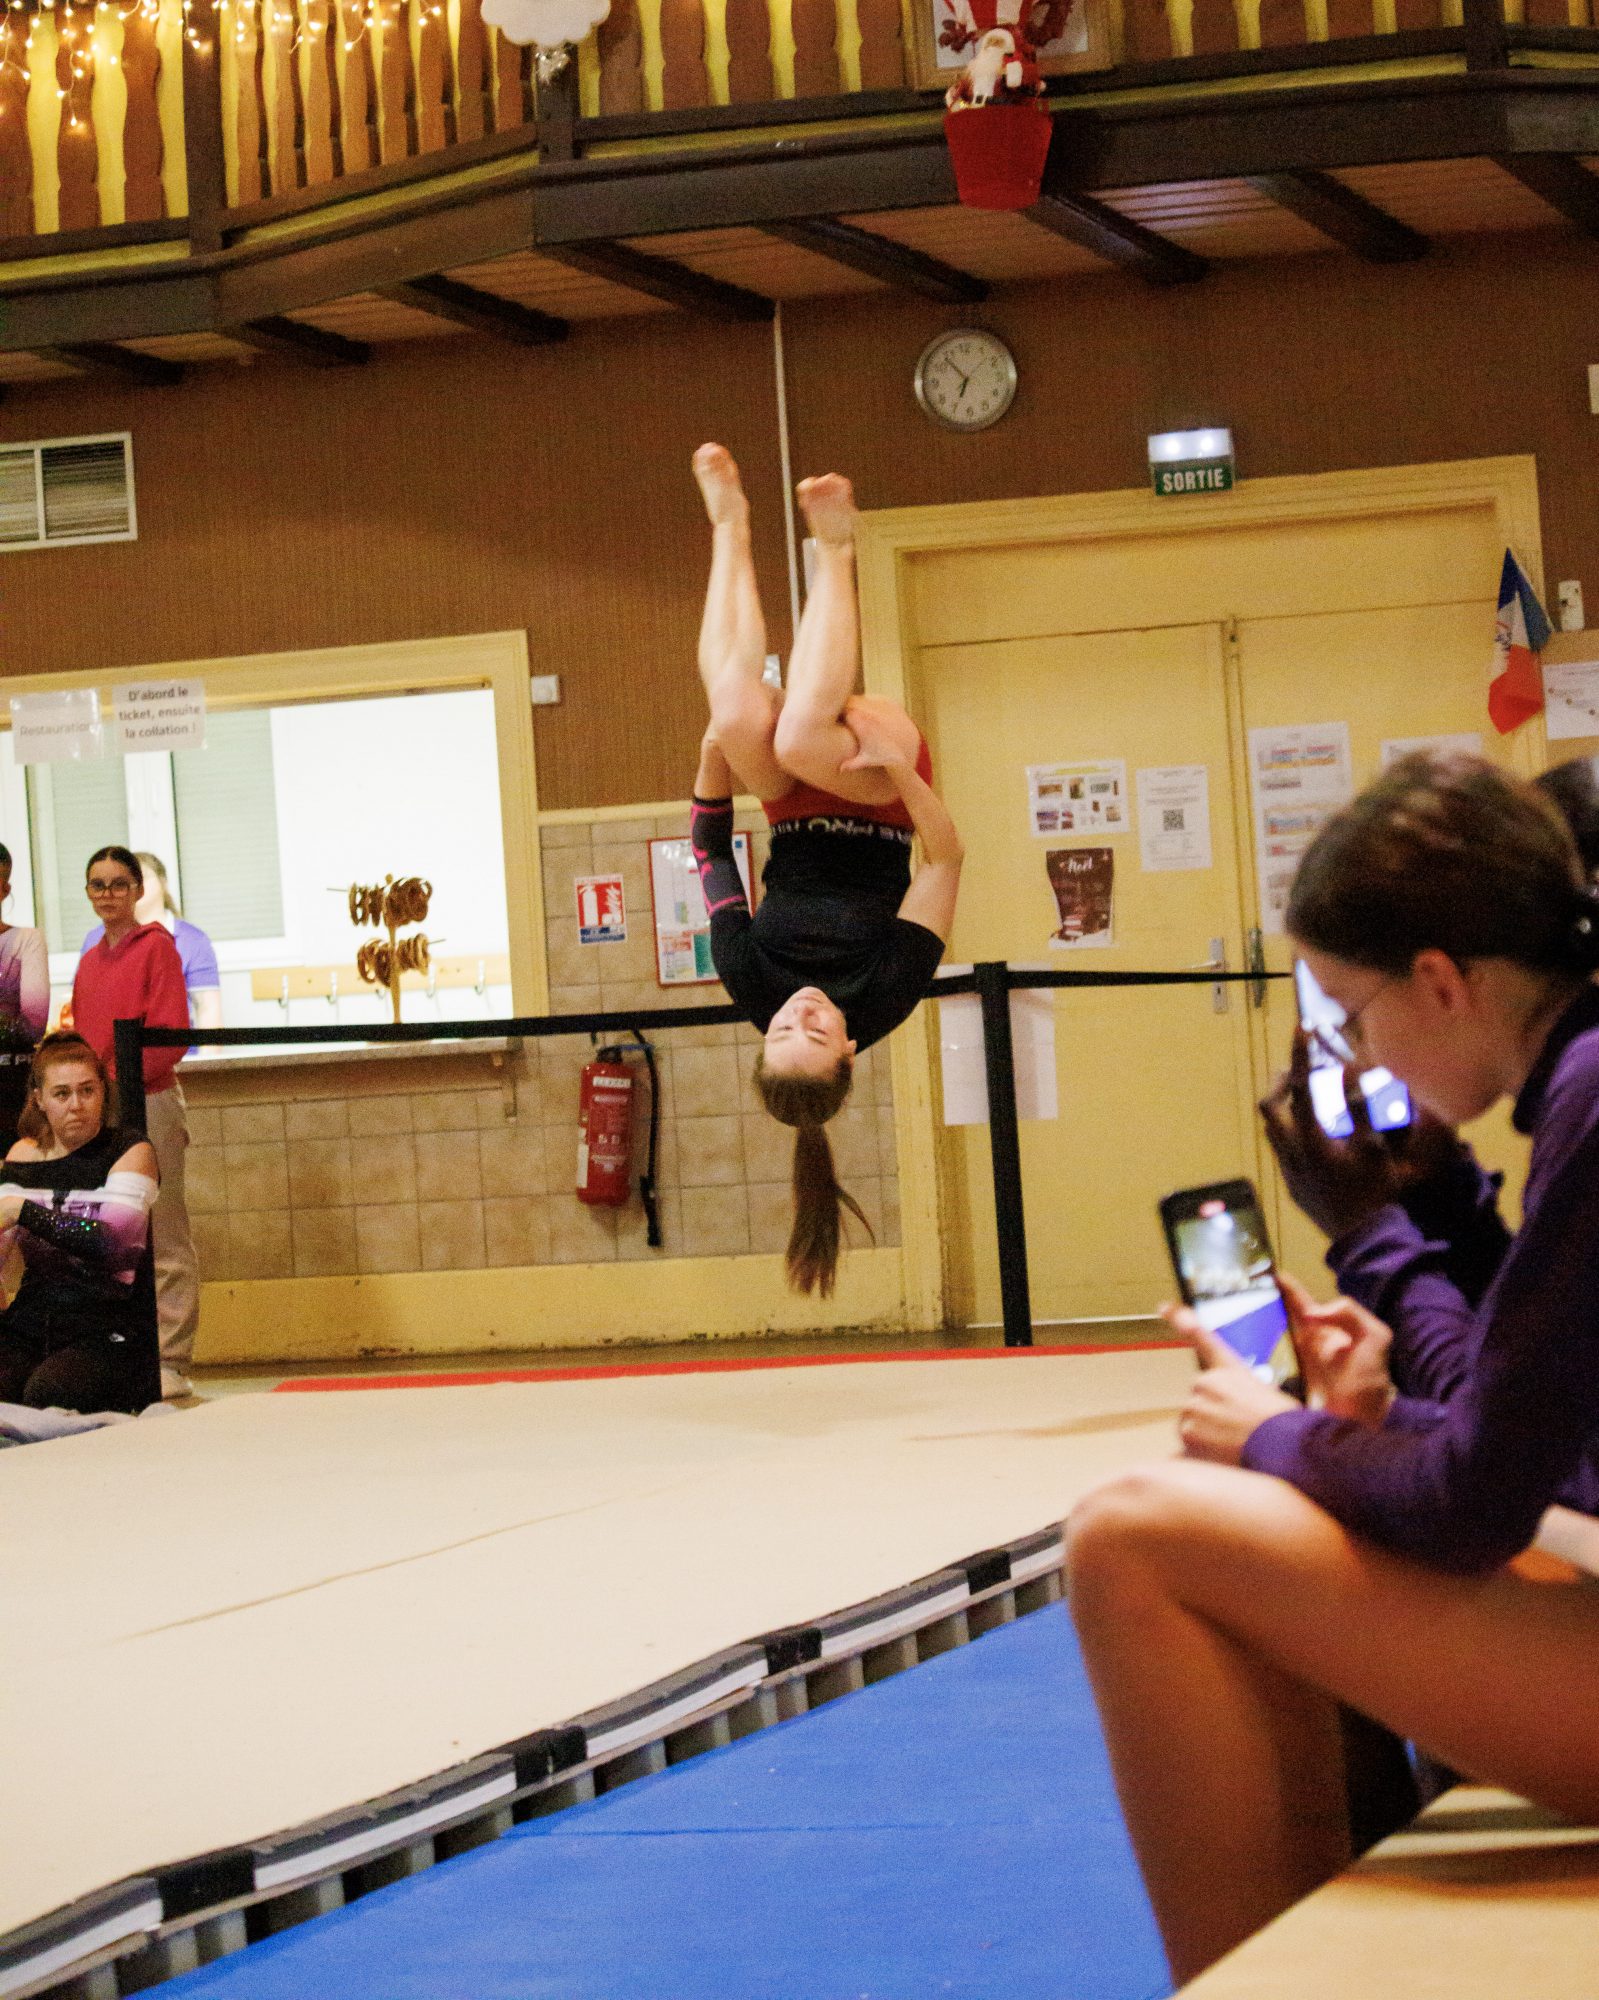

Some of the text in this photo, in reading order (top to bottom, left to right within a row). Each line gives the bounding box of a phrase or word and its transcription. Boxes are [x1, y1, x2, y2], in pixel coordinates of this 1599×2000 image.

[1163, 468, 1225, 493] SORTIE
[128, 687, 188, 701] D'abord le
[119, 704, 200, 721] ticket, ensuite
[125, 728, 136, 739] la
[139, 725, 188, 738] collation
